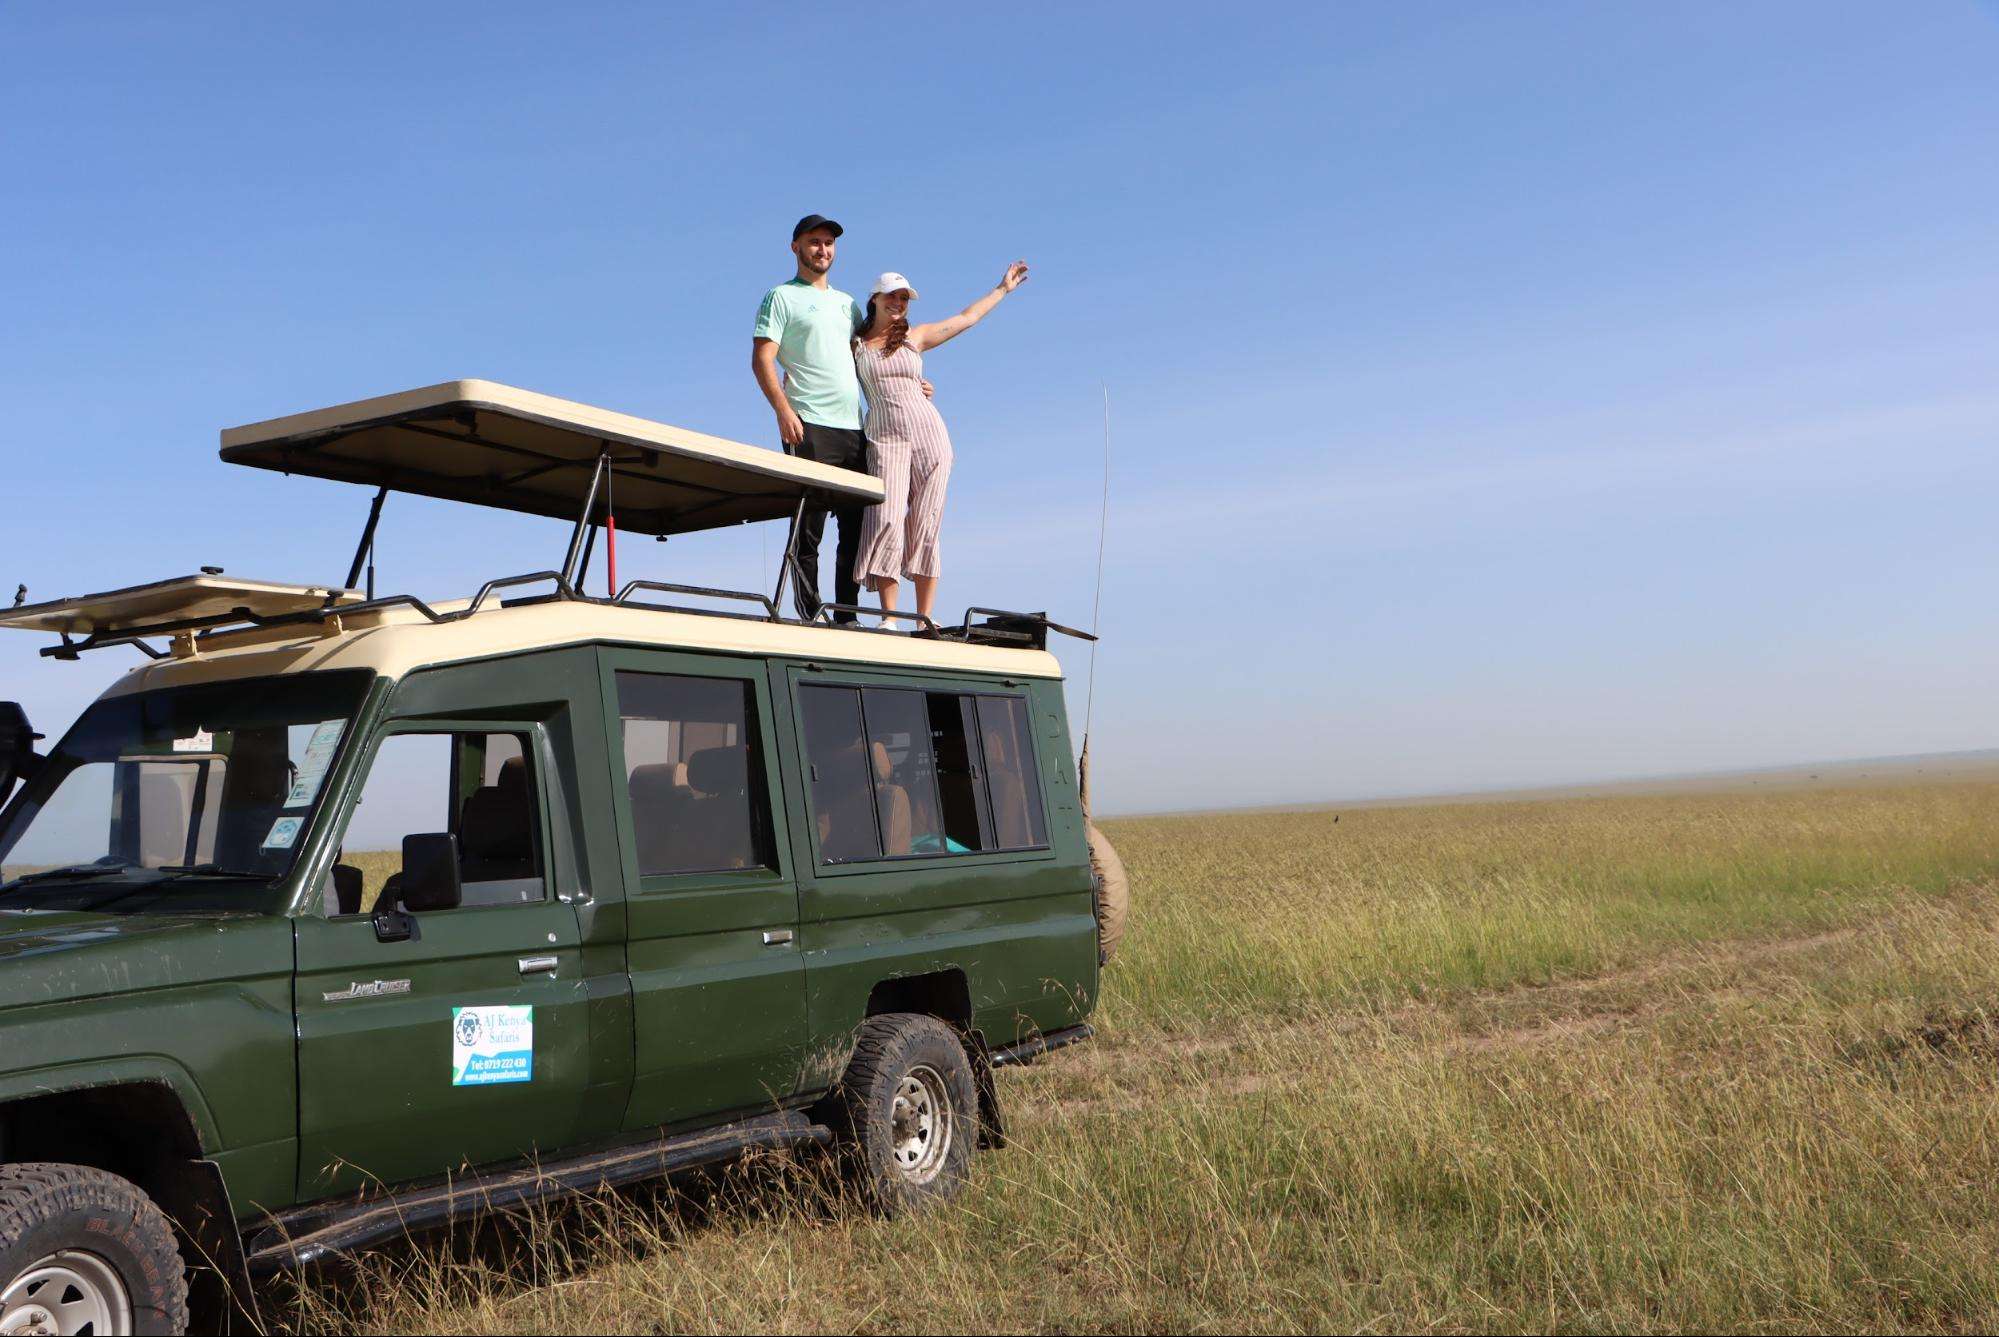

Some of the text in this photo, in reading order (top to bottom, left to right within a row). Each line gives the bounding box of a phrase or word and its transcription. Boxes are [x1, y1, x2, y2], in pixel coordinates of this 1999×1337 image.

[498, 1013, 527, 1027] Kenya
[489, 1030, 520, 1043] Safaris
[501, 1058, 513, 1068] 222
